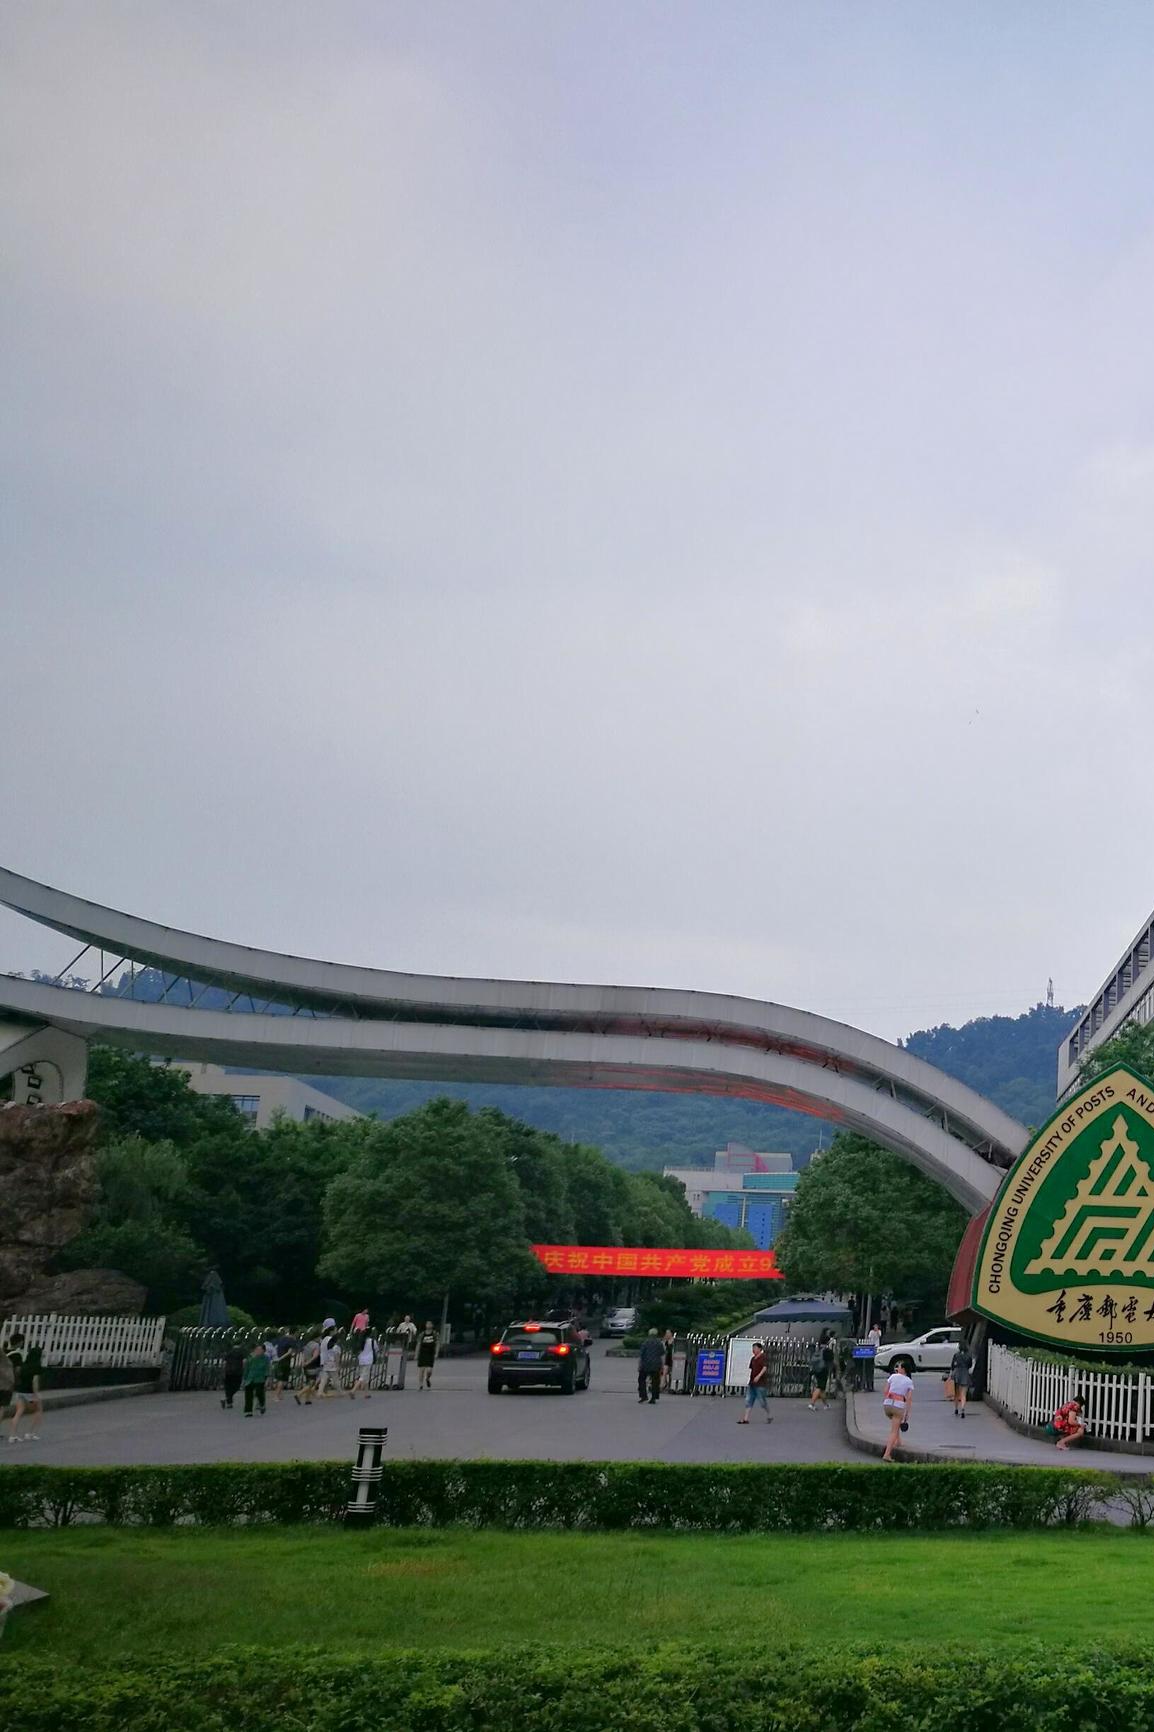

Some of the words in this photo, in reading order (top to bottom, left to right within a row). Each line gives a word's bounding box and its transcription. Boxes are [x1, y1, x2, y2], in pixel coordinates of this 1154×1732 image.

[988, 1206, 1019, 1294] CHONGQING
[1012, 1131, 1063, 1204] UNIVERSITY
[1061, 1115, 1077, 1134] OF
[1076, 1086, 1115, 1119] POSTS
[544, 1251, 780, 1273] 庆祝中国共产党成立9
[1098, 1332, 1133, 1344] 1950
